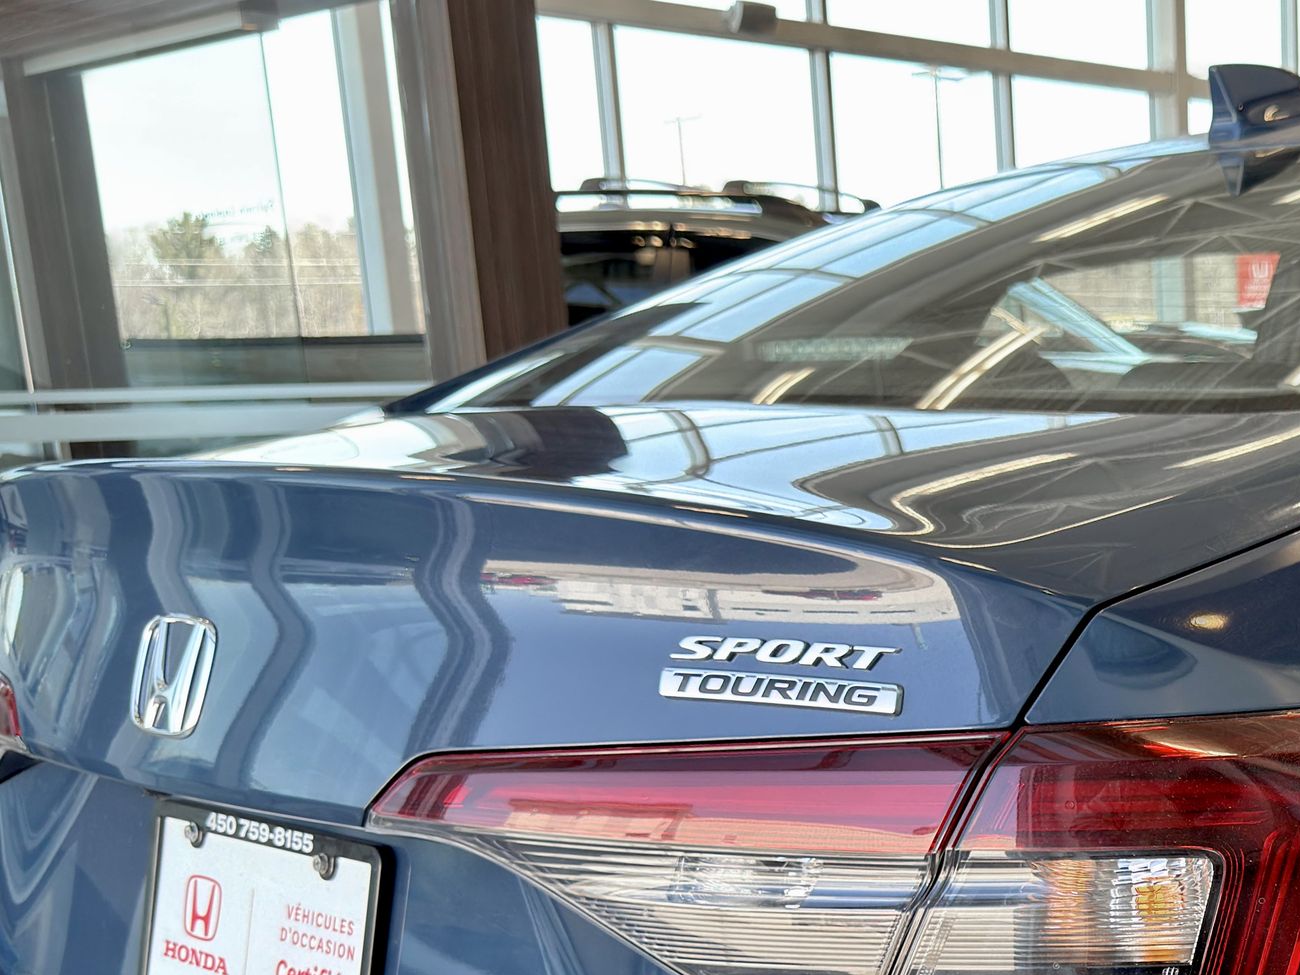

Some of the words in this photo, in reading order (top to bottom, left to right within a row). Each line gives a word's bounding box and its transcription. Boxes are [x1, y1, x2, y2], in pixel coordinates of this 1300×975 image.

[669, 635, 902, 671] SPORT
[673, 672, 882, 707] TOURING
[205, 812, 237, 836] 450
[238, 819, 314, 853] 759-8155
[286, 903, 355, 936] VÉHICULES
[280, 926, 356, 961] D'OCCASION
